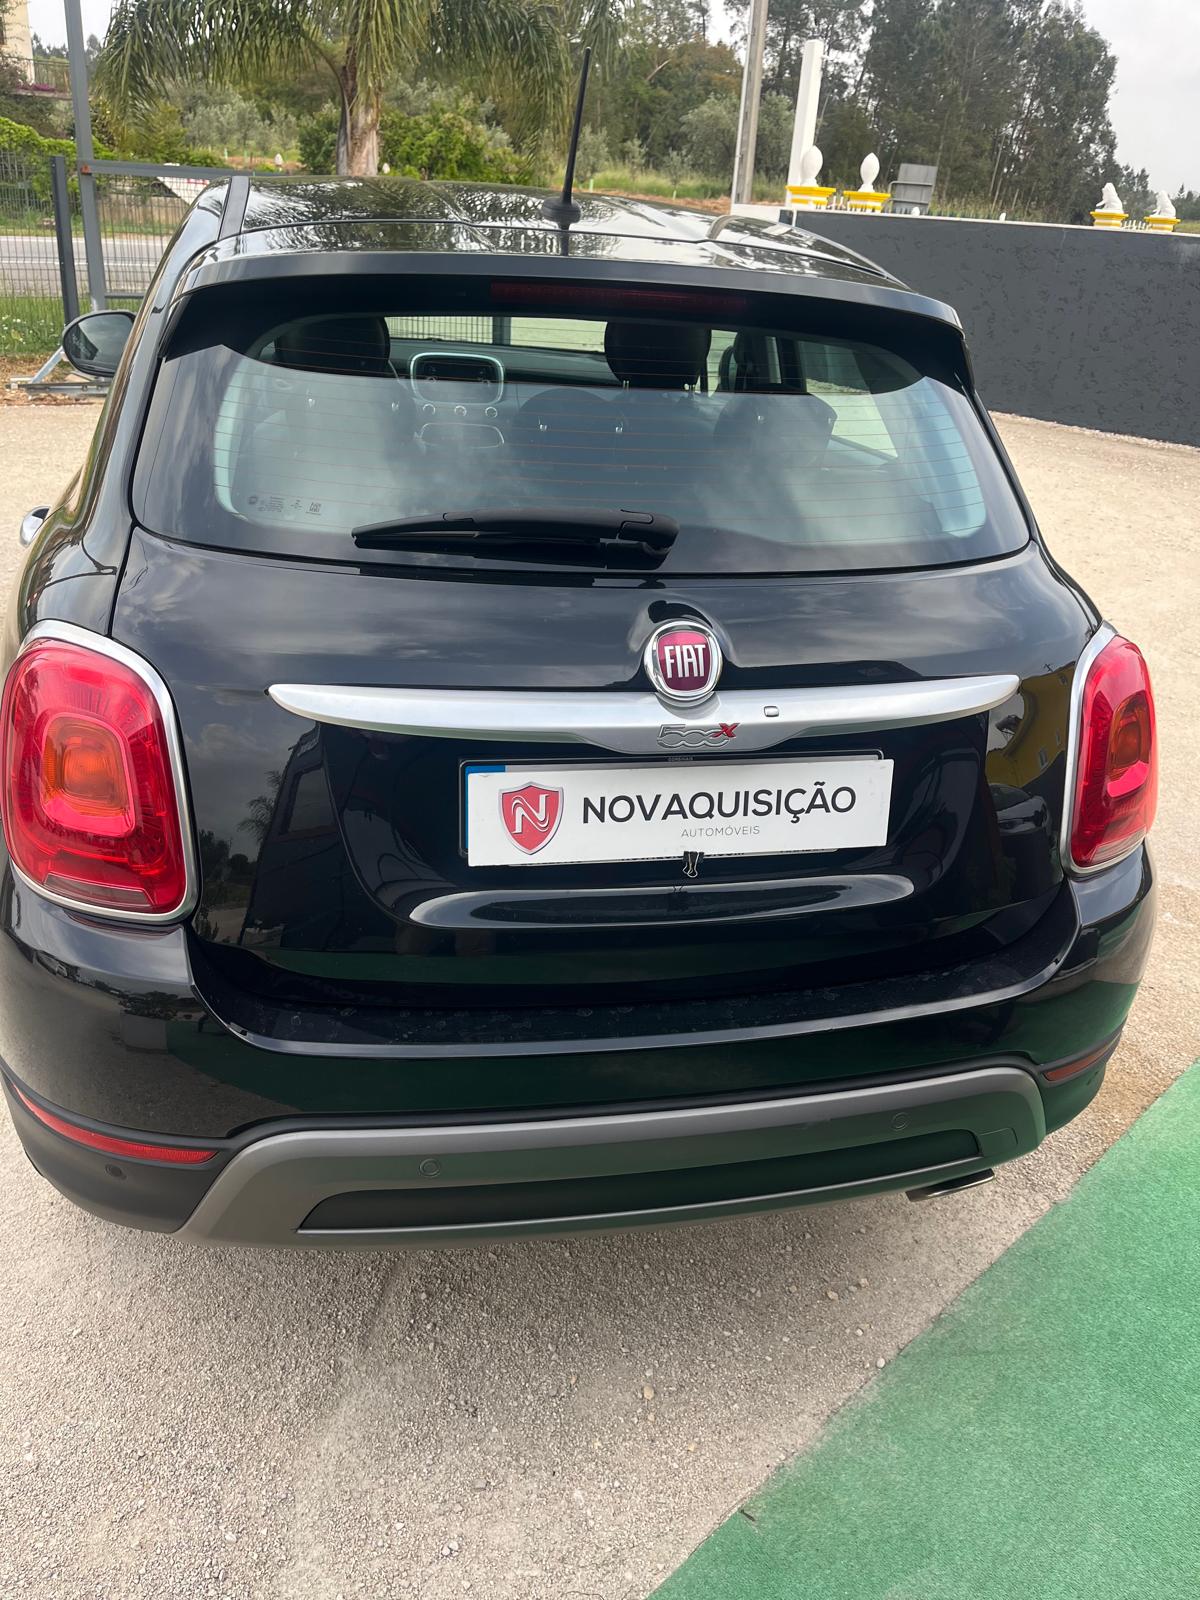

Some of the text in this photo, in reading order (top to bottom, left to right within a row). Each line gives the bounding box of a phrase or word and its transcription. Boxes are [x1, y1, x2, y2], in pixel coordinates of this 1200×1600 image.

[664, 644, 706, 679] FIAT
[511, 794, 550, 834] N
[583, 781, 856, 824] NOVAQUISIÇÃO
[681, 825, 760, 838] AUTOMÓVEIS
